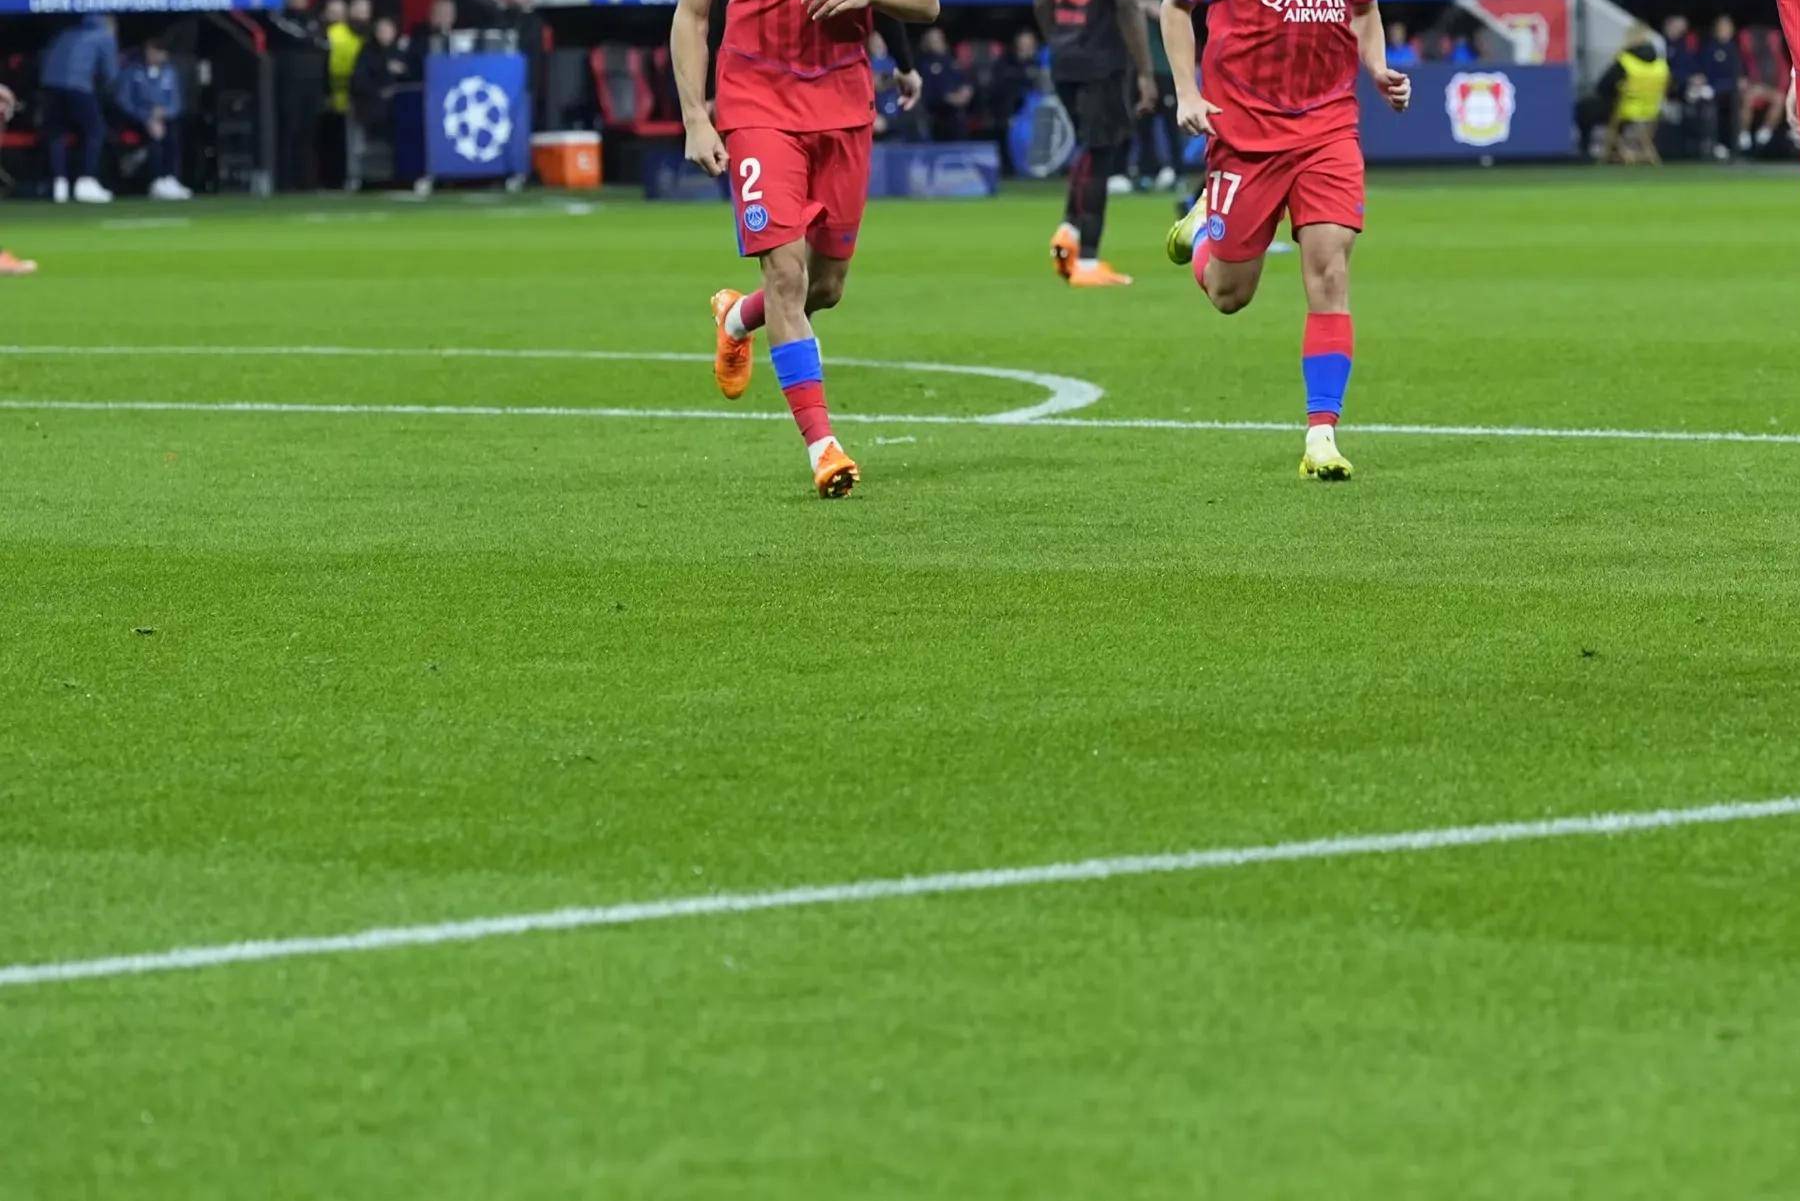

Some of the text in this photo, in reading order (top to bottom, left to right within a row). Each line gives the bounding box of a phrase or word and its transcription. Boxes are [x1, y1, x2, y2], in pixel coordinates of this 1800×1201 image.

[1283, 8, 1345, 22] AIRWAYS
[739, 157, 763, 202] 2
[1209, 170, 1242, 215] 17
